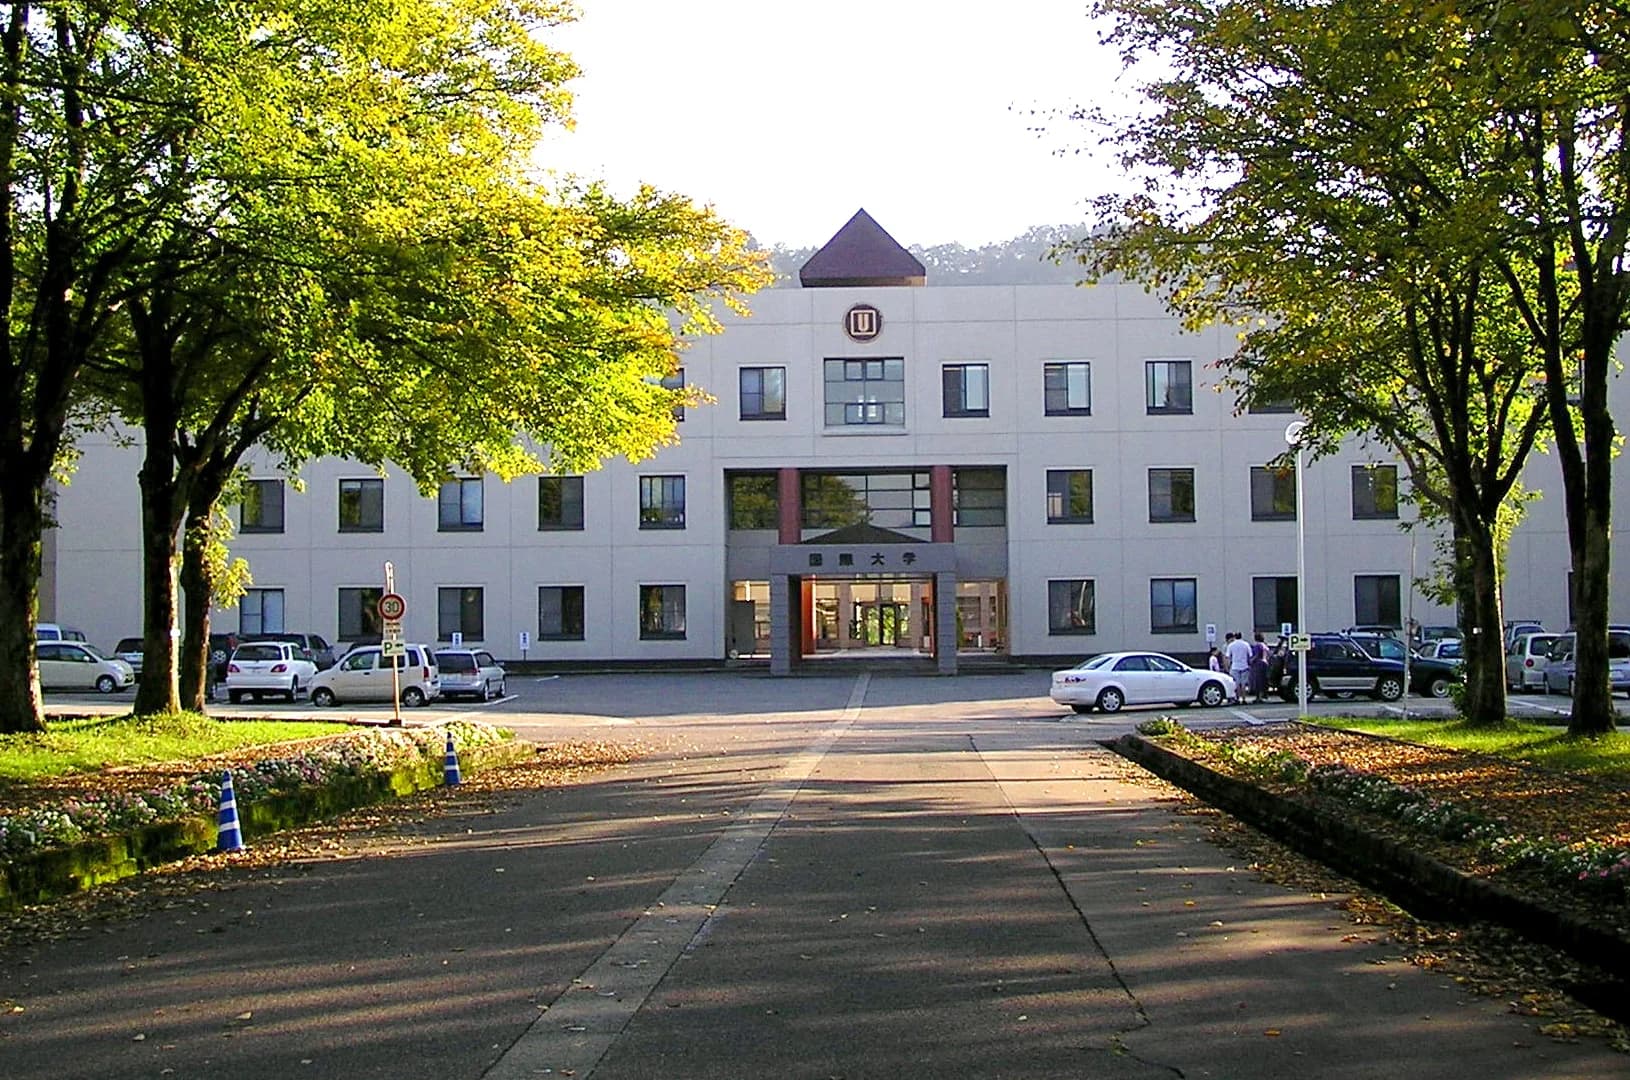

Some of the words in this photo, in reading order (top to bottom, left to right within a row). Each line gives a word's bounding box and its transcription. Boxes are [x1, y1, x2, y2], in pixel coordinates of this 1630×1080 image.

[384, 601, 400, 613] 30
[384, 642, 393, 655] P
[1291, 635, 1299, 649] P
